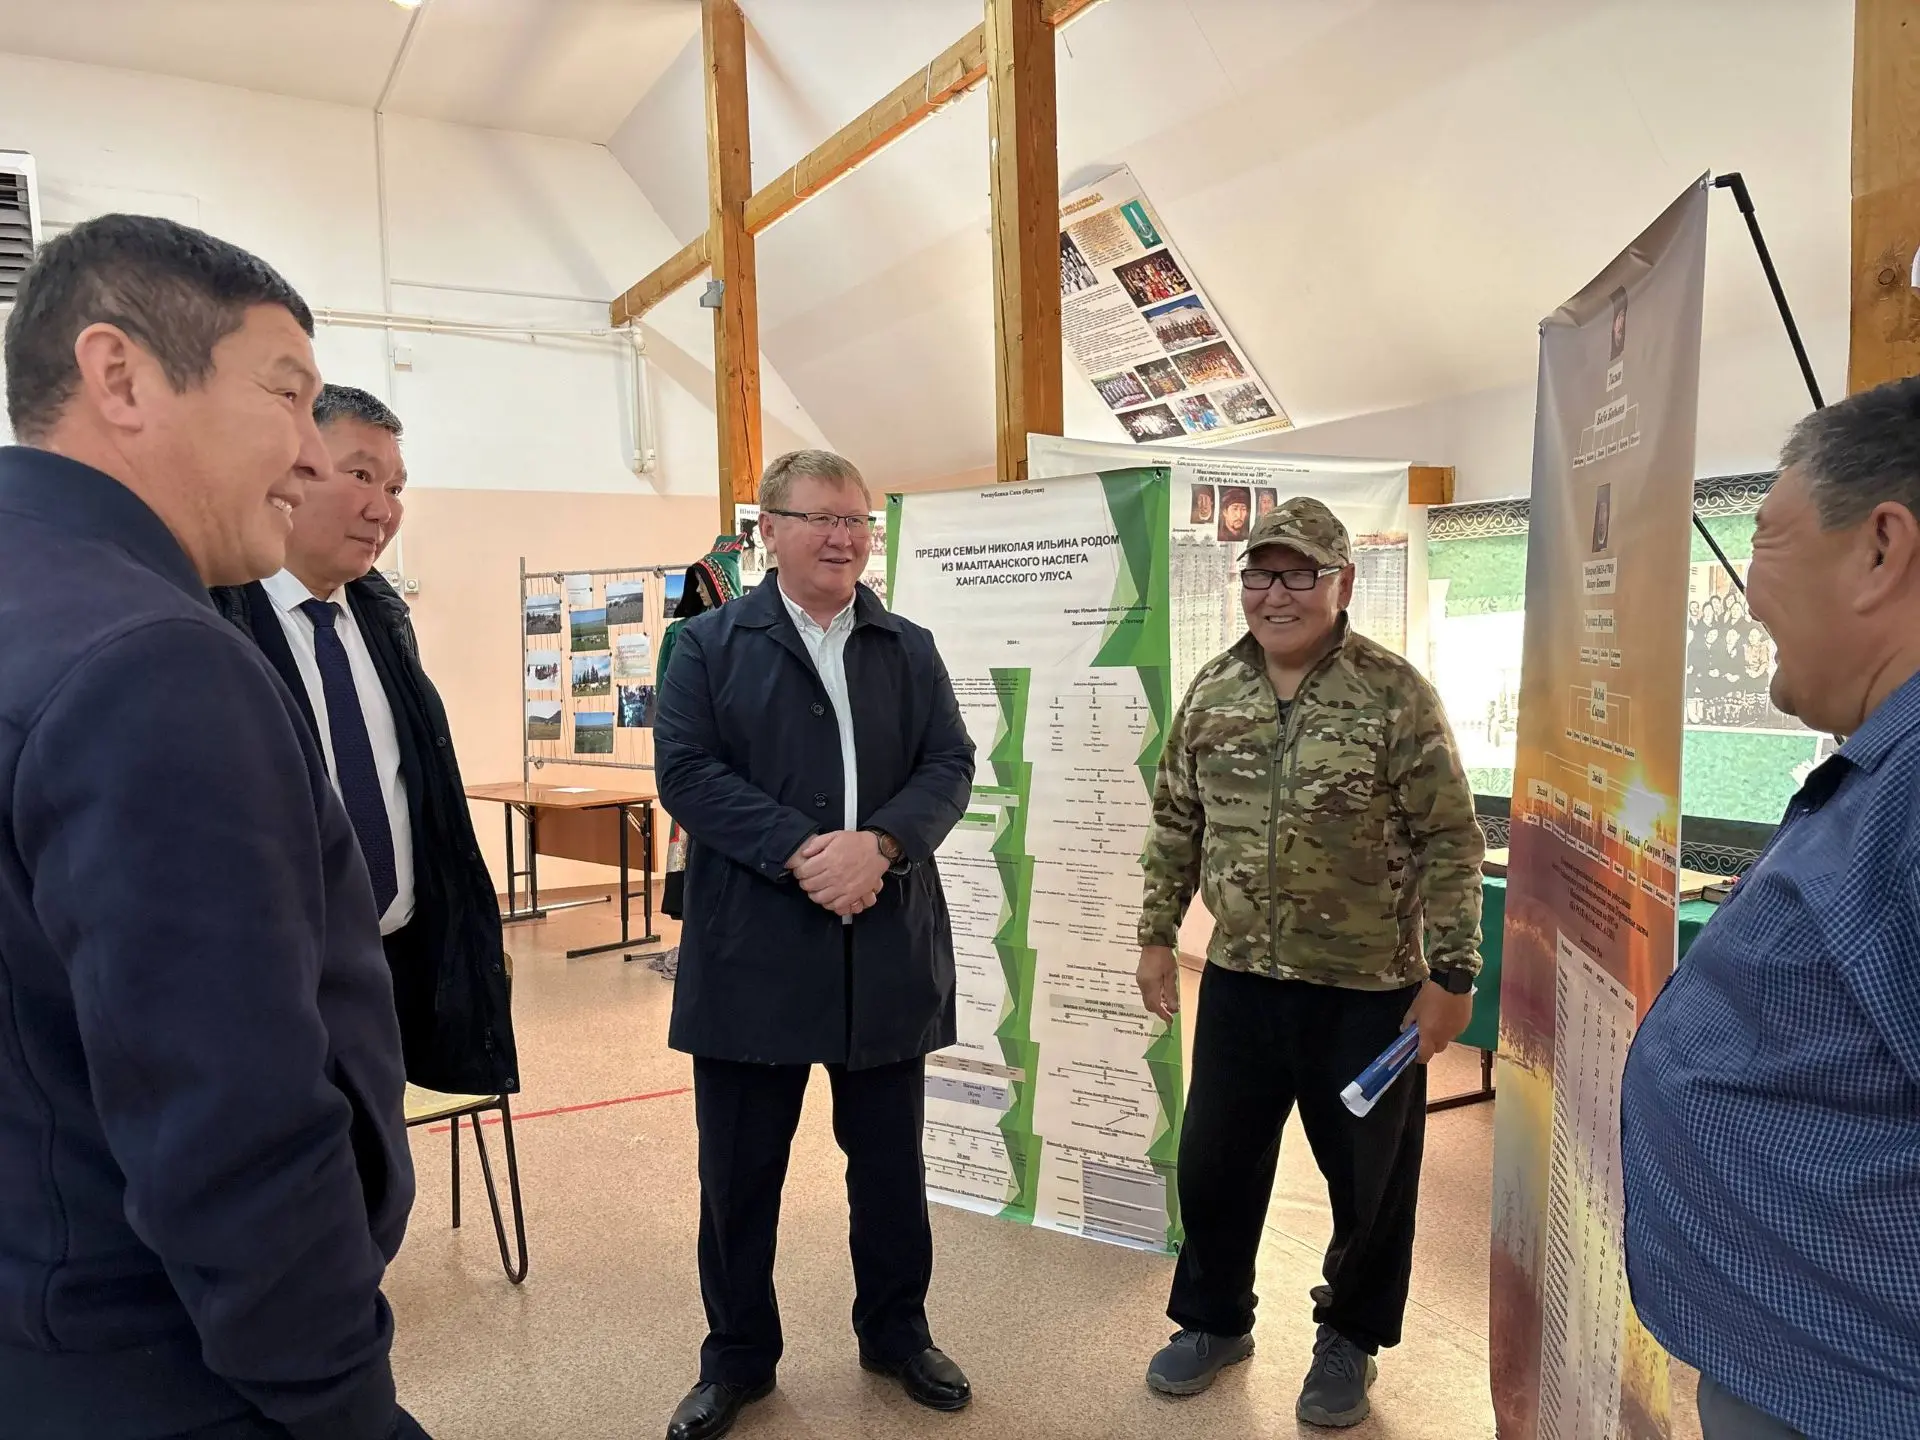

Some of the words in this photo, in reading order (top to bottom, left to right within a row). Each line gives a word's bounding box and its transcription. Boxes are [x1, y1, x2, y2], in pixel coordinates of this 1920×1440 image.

[915, 547, 951, 559] ПРЕДКИ
[952, 544, 986, 556] СЕМЬИ
[988, 541, 1034, 554] НИКОЛАЯ
[1036, 538, 1079, 550] ИЛЬИНА
[1081, 535, 1120, 547] РОДОМ
[941, 562, 954, 572] ИЗ
[955, 556, 1040, 571] МААЛТААНСКОГО
[1041, 553, 1089, 566] НАСЛЕГА
[956, 572, 1038, 586] ХАНГАЛАССКОГО
[1039, 570, 1073, 582] УЛУСА
